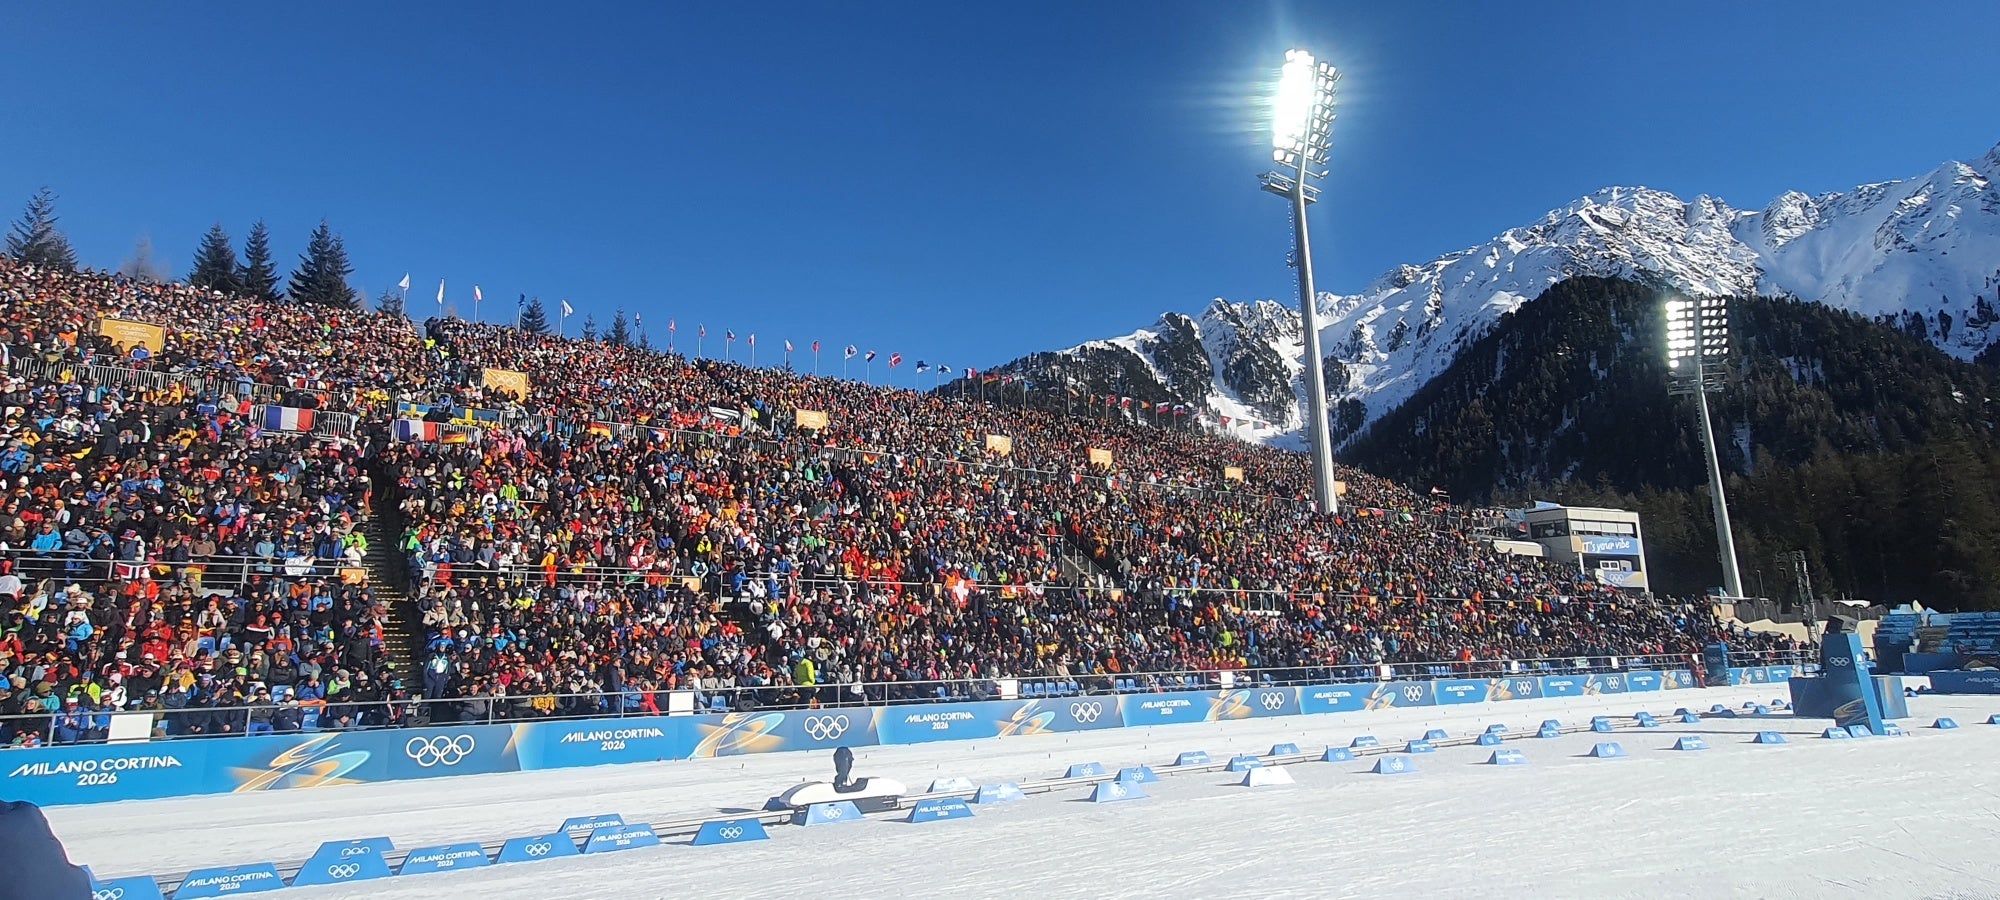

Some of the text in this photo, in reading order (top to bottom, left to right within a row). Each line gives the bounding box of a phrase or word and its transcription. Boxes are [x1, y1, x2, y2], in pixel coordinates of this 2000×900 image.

[904, 711, 974, 723] MILANO CORTINA
[932, 721, 949, 730] 2026
[560, 728, 664, 743] MILANO CORTINA
[600, 740, 625, 751] 2026
[8, 755, 182, 777] MILANO CORTINA
[77, 772, 118, 786] 2026
[565, 820, 622, 831] MILANO CORTINA
[593, 831, 653, 843] MILANO CORTINA
[409, 850, 480, 864] MILANO CORTINA
[436, 860, 454, 868] 2026
[186, 871, 274, 888] MILANO CORTINA
[219, 882, 241, 891] 2026
